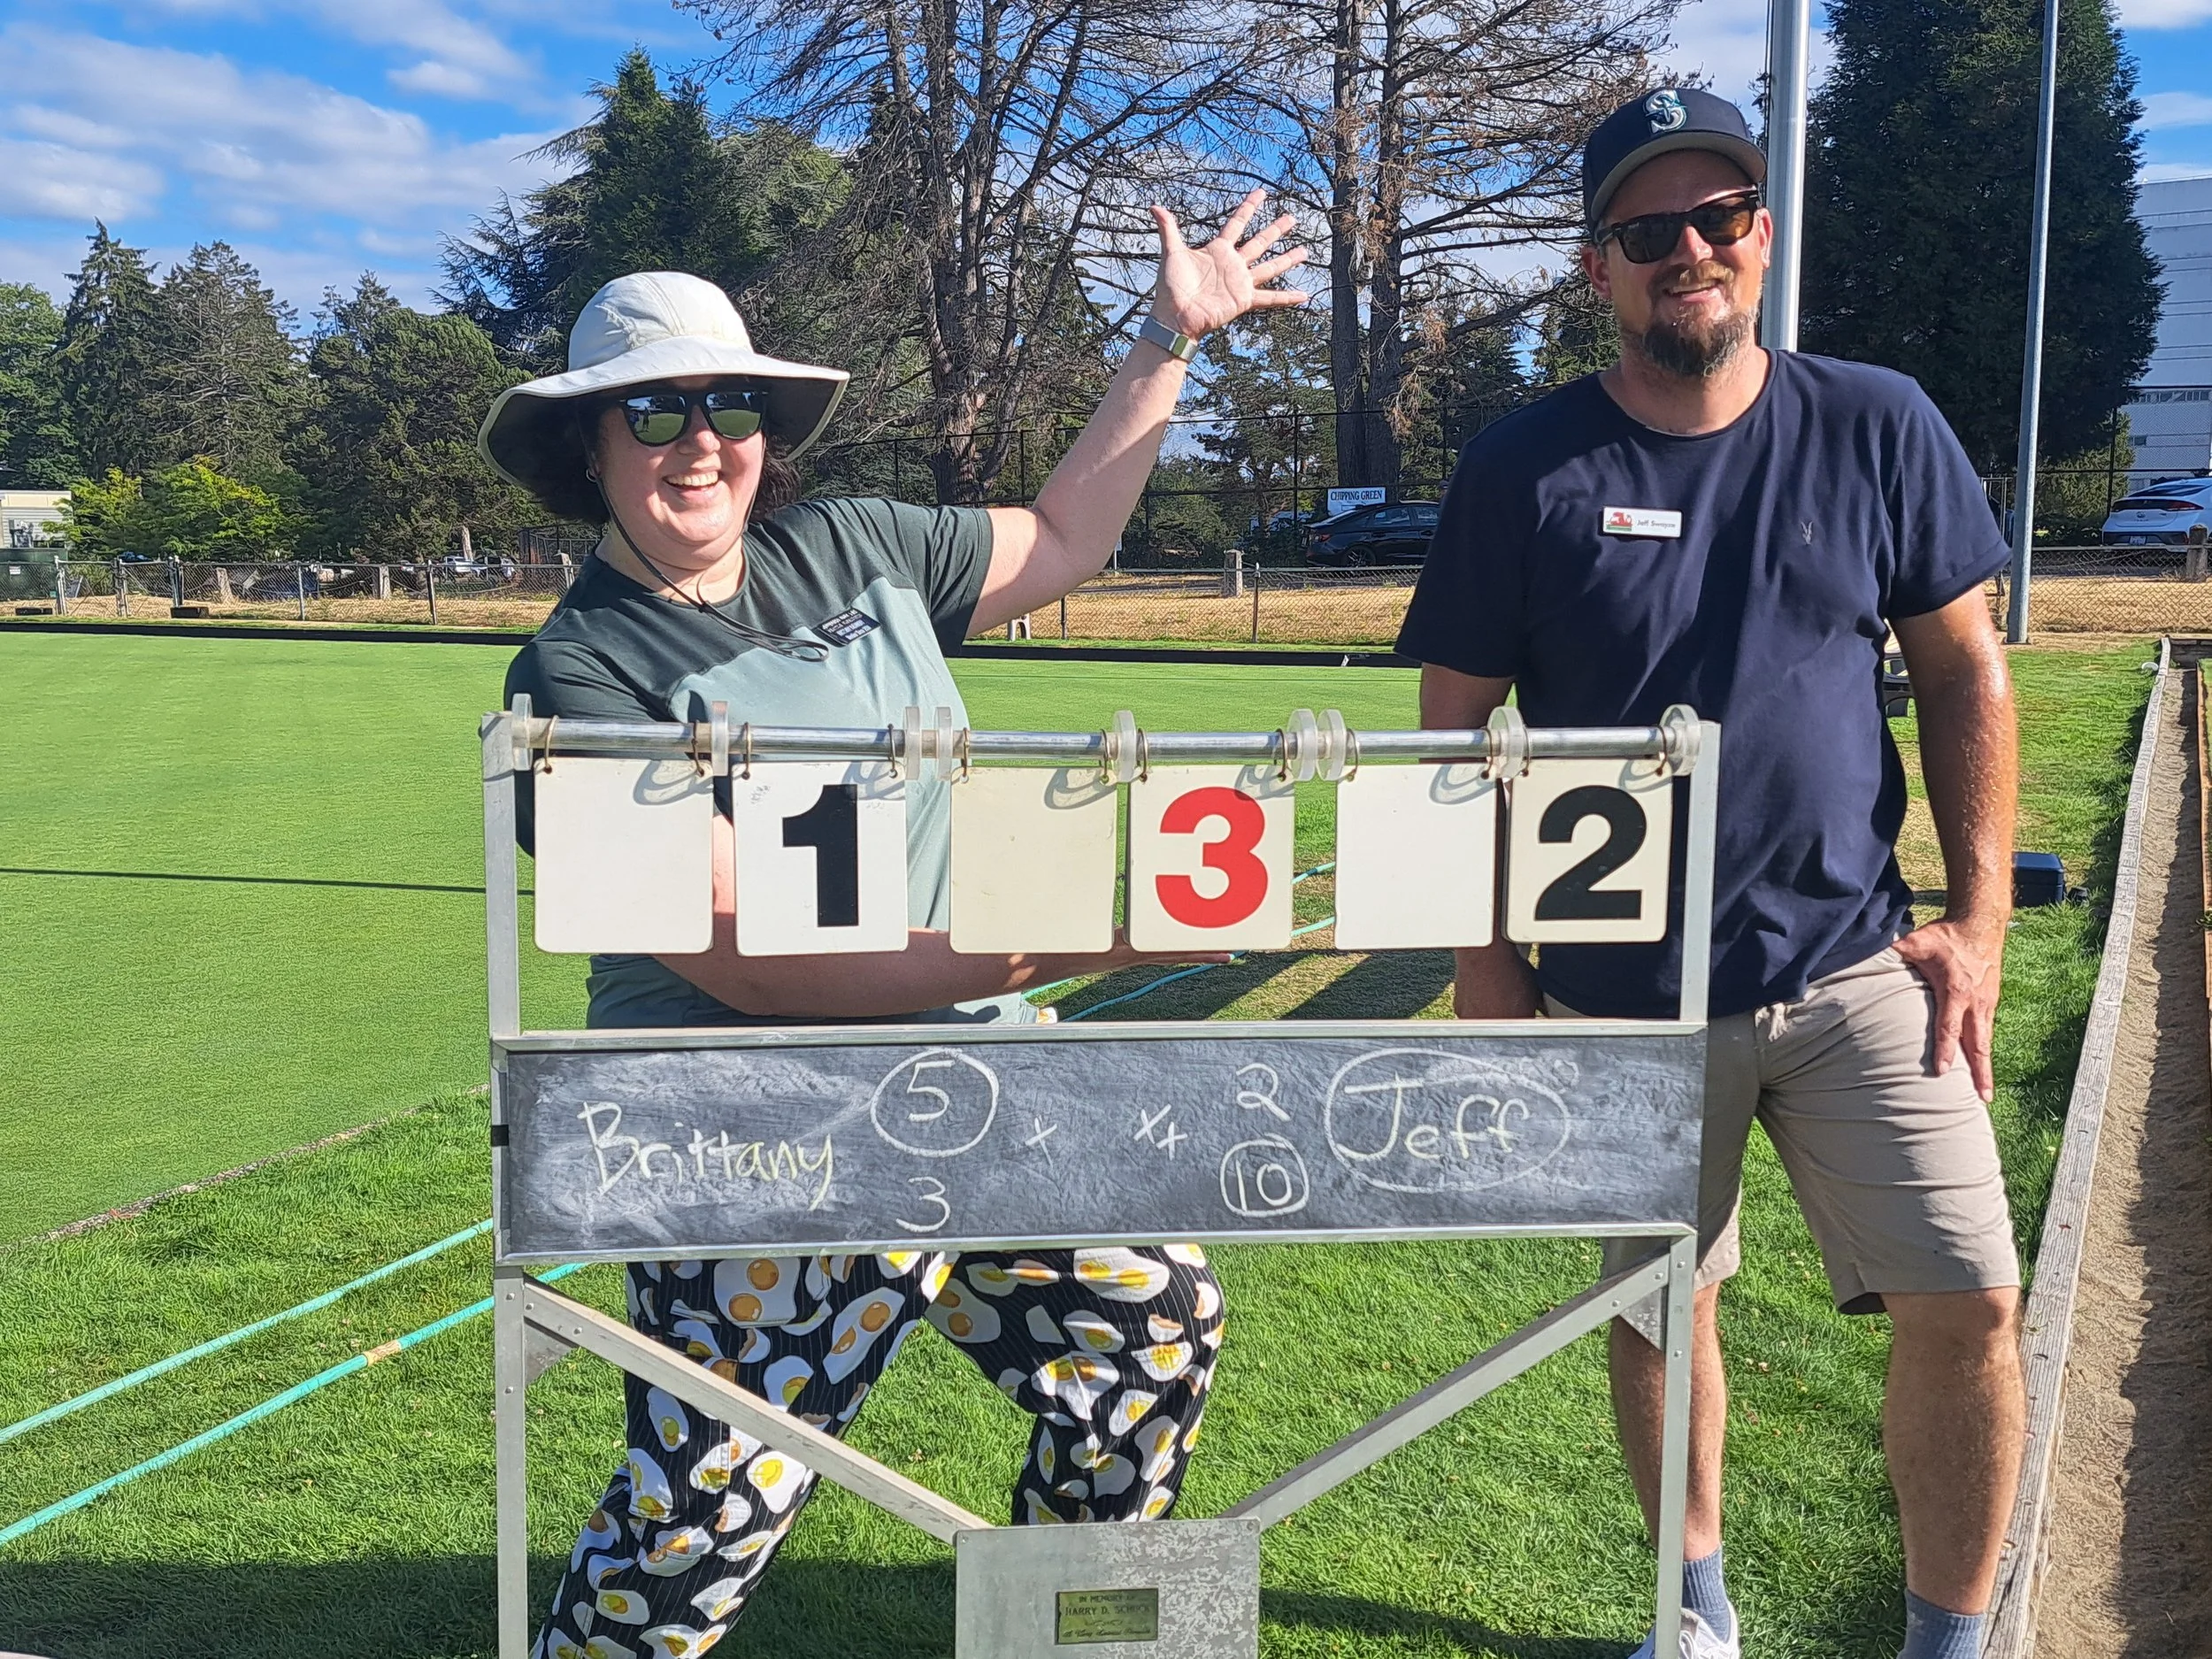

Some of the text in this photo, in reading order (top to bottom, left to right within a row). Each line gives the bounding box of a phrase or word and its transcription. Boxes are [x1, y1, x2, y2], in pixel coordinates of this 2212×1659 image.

[1330, 489, 1383, 501] CHIPPING GREEN
[782, 784, 859, 927] 1
[1155, 786, 1268, 928] 3
[1534, 785, 1647, 920] 2
[906, 1060, 956, 1122] 5
[1236, 1063, 1291, 1121] 2
[1336, 1071, 1530, 1162] Jeff
[577, 1101, 833, 1211] Brittany
[1234, 1160, 1293, 1212] 10
[895, 1176, 952, 1234] 3
[1064, 1606, 1096, 1616] HARRY
[1101, 1606, 1110, 1615] D.
